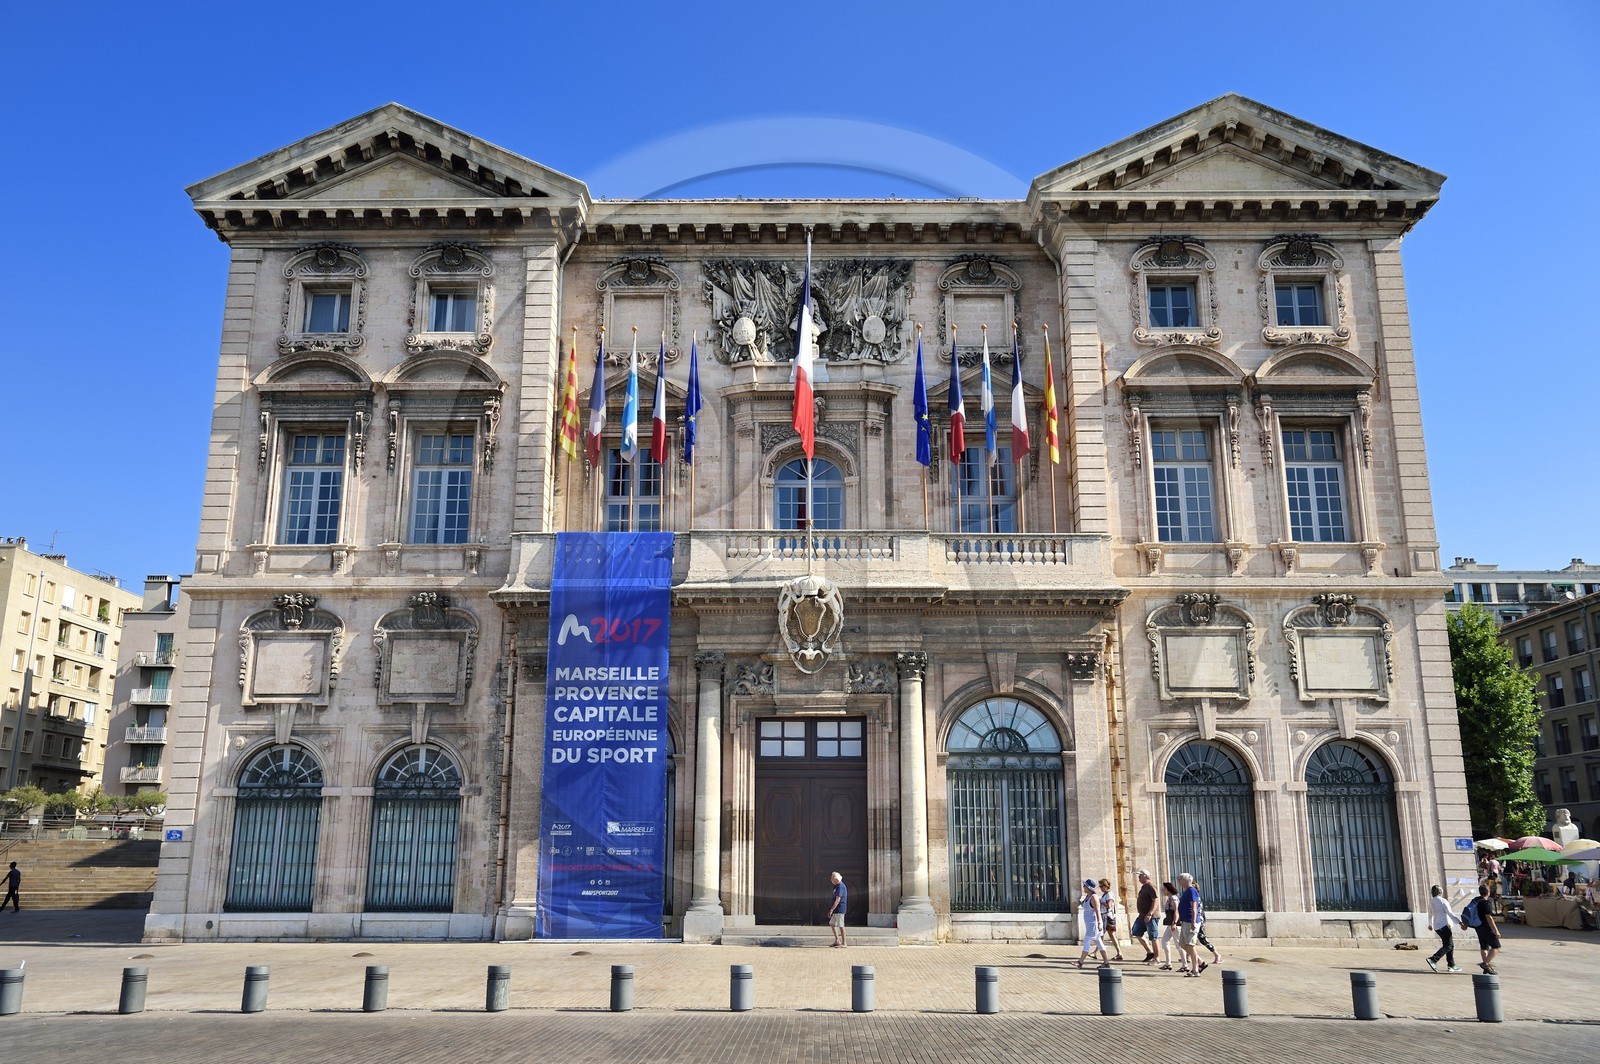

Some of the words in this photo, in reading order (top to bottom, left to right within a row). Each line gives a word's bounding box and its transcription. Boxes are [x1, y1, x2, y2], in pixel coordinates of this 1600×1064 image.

[555, 666, 659, 681] MARSEILLE
[554, 686, 659, 701] PROVENCE
[553, 706, 658, 722] CAPITALE
[552, 727, 658, 741] EUROPÉENNE
[551, 748, 581, 763] DU
[587, 748, 657, 763] SPORT
